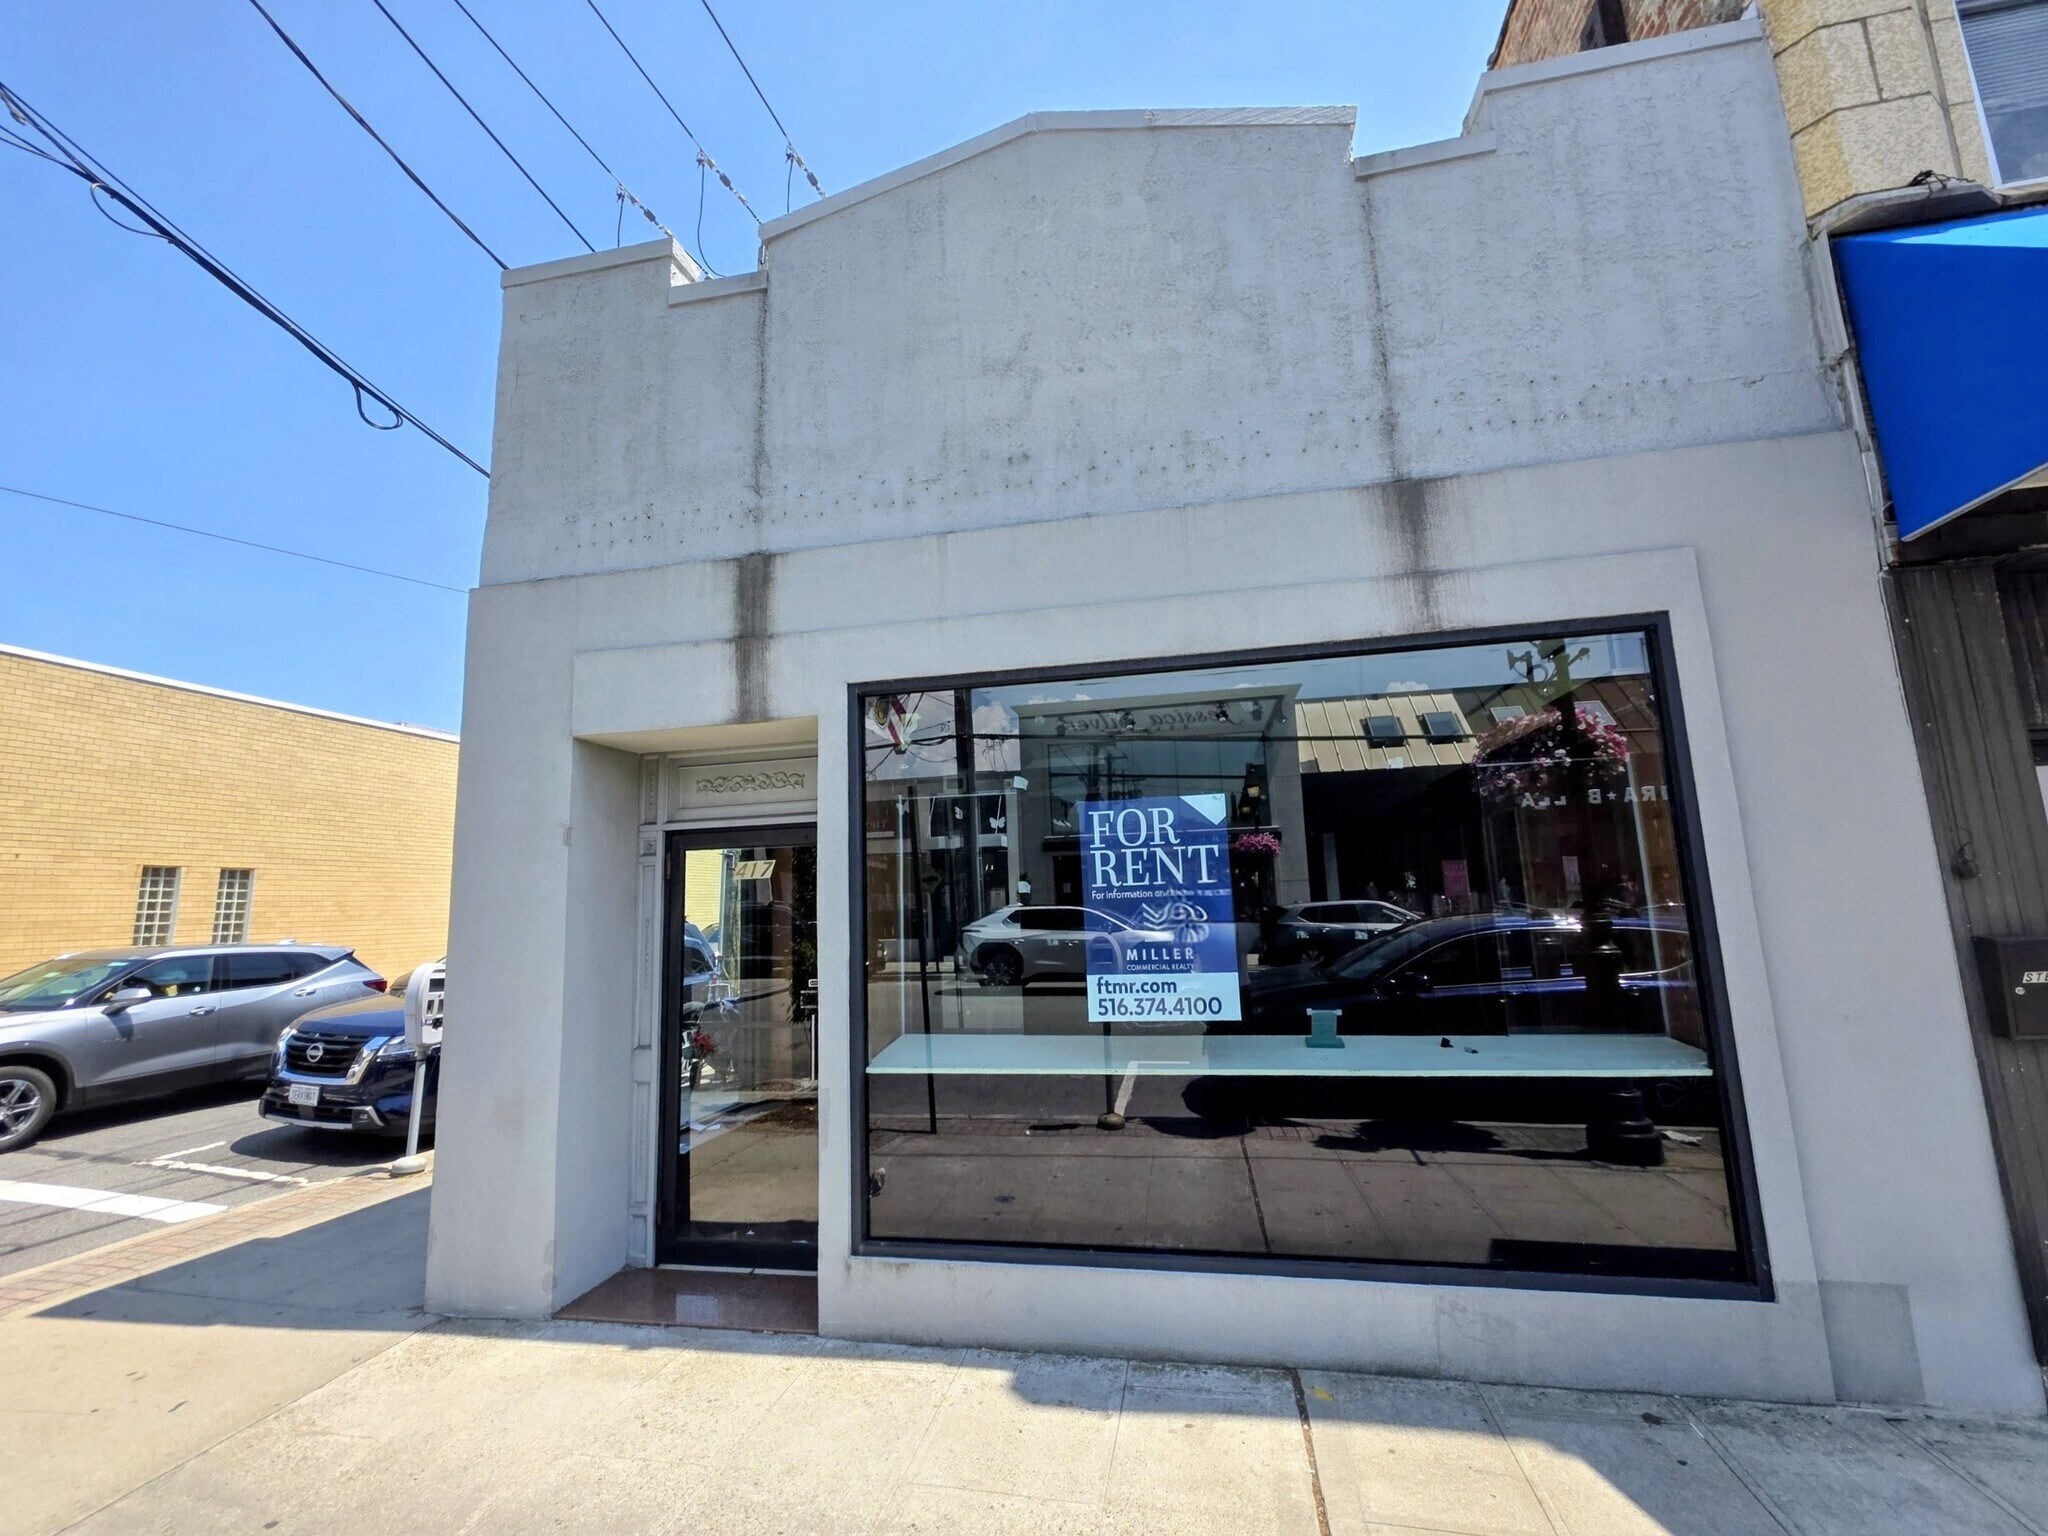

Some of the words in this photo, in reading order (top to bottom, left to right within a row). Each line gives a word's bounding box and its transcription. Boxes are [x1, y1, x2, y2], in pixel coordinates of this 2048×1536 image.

[1088, 807, 1180, 847] FOR
[736, 861, 772, 877] 417
[1090, 844, 1219, 887] RENT
[1091, 890, 1105, 900] For
[1106, 888, 1153, 899] information
[1126, 947, 1194, 961] MILLER
[1126, 963, 1170, 971] COMMERCIAL
[1172, 962, 1195, 971] REALTY
[1096, 976, 1178, 995] ftmr.com
[1098, 996, 1223, 1016] 516.374.4100
